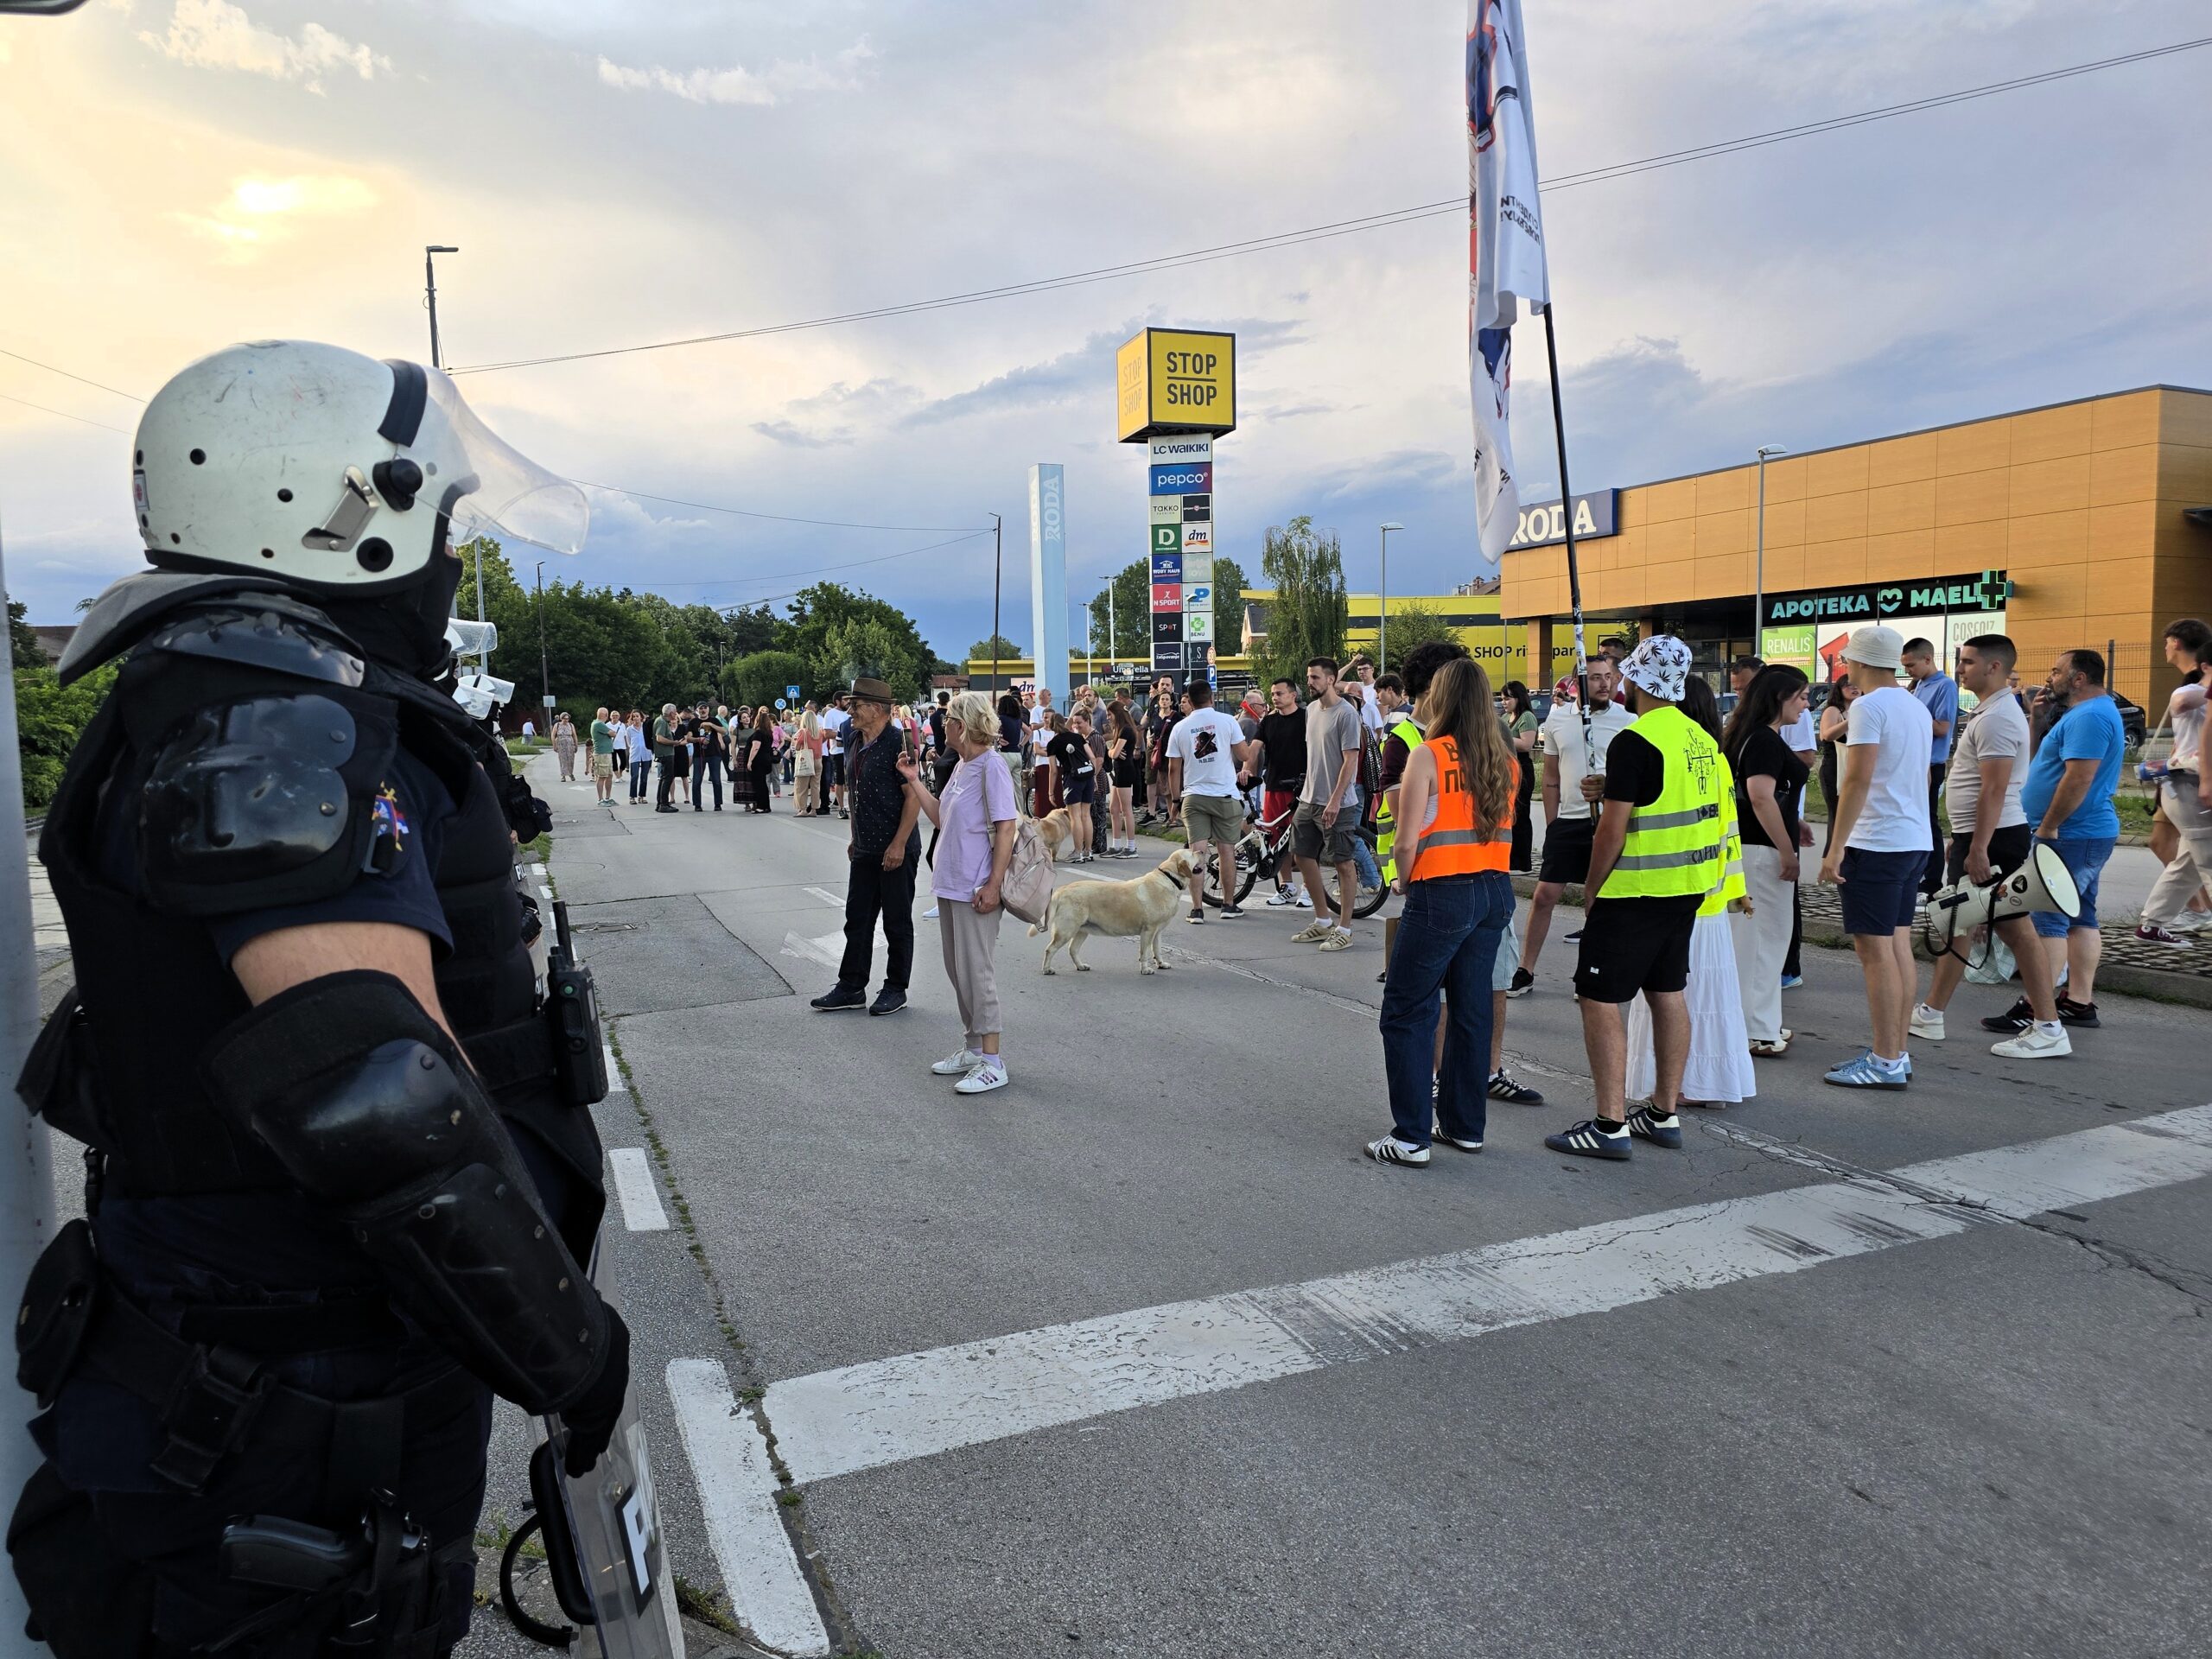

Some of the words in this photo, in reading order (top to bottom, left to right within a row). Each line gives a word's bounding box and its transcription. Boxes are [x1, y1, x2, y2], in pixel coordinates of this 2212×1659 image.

[1123, 356, 1142, 385] STOP
[1166, 351, 1217, 375] STOP
[1124, 387, 1142, 416] SHOP
[1166, 383, 1217, 406] SHOP
[1154, 445, 1166, 454] LC
[1158, 473, 1205, 486] pepco
[1043, 474, 1061, 543] RODA
[1510, 499, 1597, 545] RODA
[1159, 528, 1175, 545] D
[1188, 529, 1206, 540] dm
[1771, 594, 1871, 619] APOTEKA
[1474, 646, 1512, 658] SHOP
[1552, 647, 1586, 659] par
[1767, 637, 1810, 654] RENALIS
[1210, 667, 1215, 681] P
